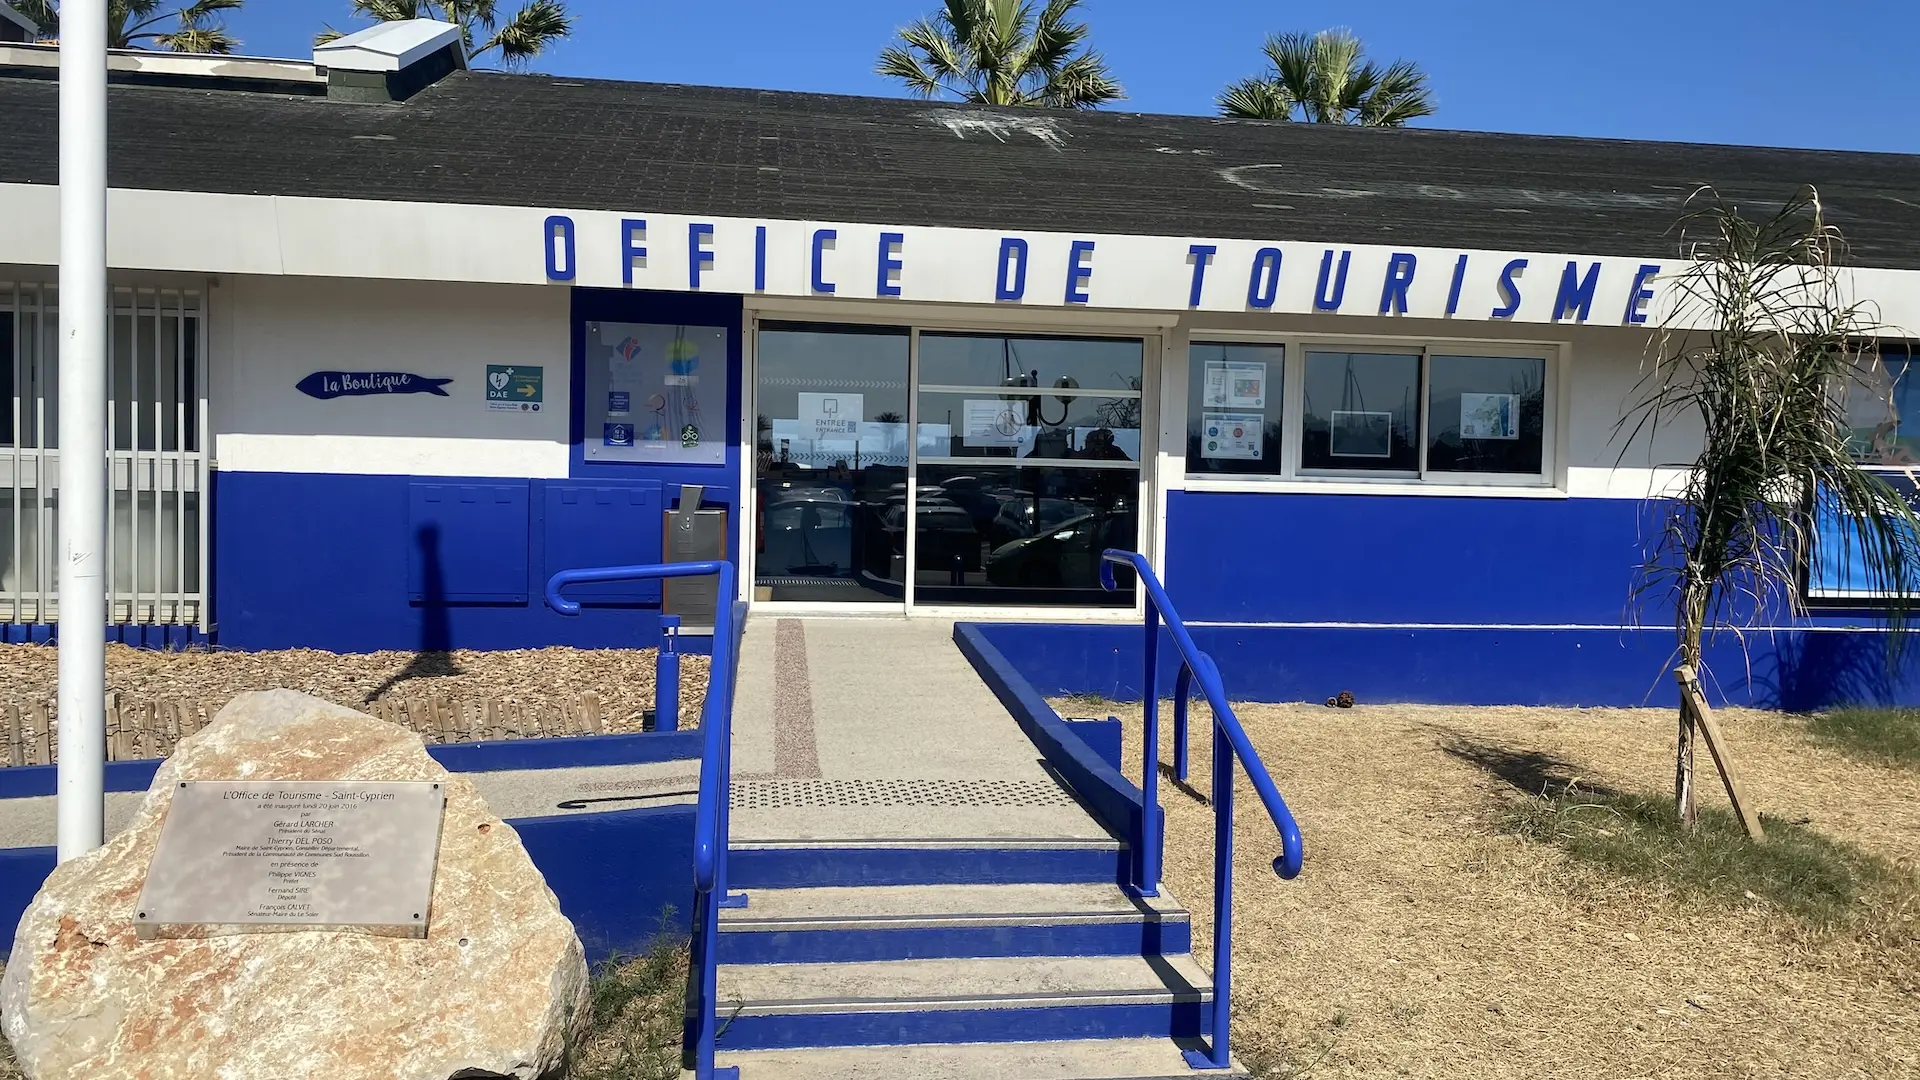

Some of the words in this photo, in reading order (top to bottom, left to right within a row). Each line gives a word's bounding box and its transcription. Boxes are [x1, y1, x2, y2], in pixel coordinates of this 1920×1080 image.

[544, 215, 904, 297] OFFICE
[996, 237, 1095, 303] DE
[1188, 244, 1661, 324] TOURISME
[323, 376, 340, 392] La
[342, 373, 411, 392] Boutique
[489, 390, 508, 398] DAE
[223, 790, 259, 800] L'Office
[262, 790, 274, 800] de
[278, 790, 322, 800] Tourisme
[331, 790, 395, 802] Saint-Cyprien
[273, 820, 299, 828] Gérard
[300, 820, 334, 828] LARCHER
[267, 837, 294, 846] Thierry
[295, 837, 310, 845] DEL
[311, 837, 333, 845] POSO
[268, 871, 293, 879] Philippe
[259, 903, 286, 911] François
[287, 903, 311, 911] CALVET
